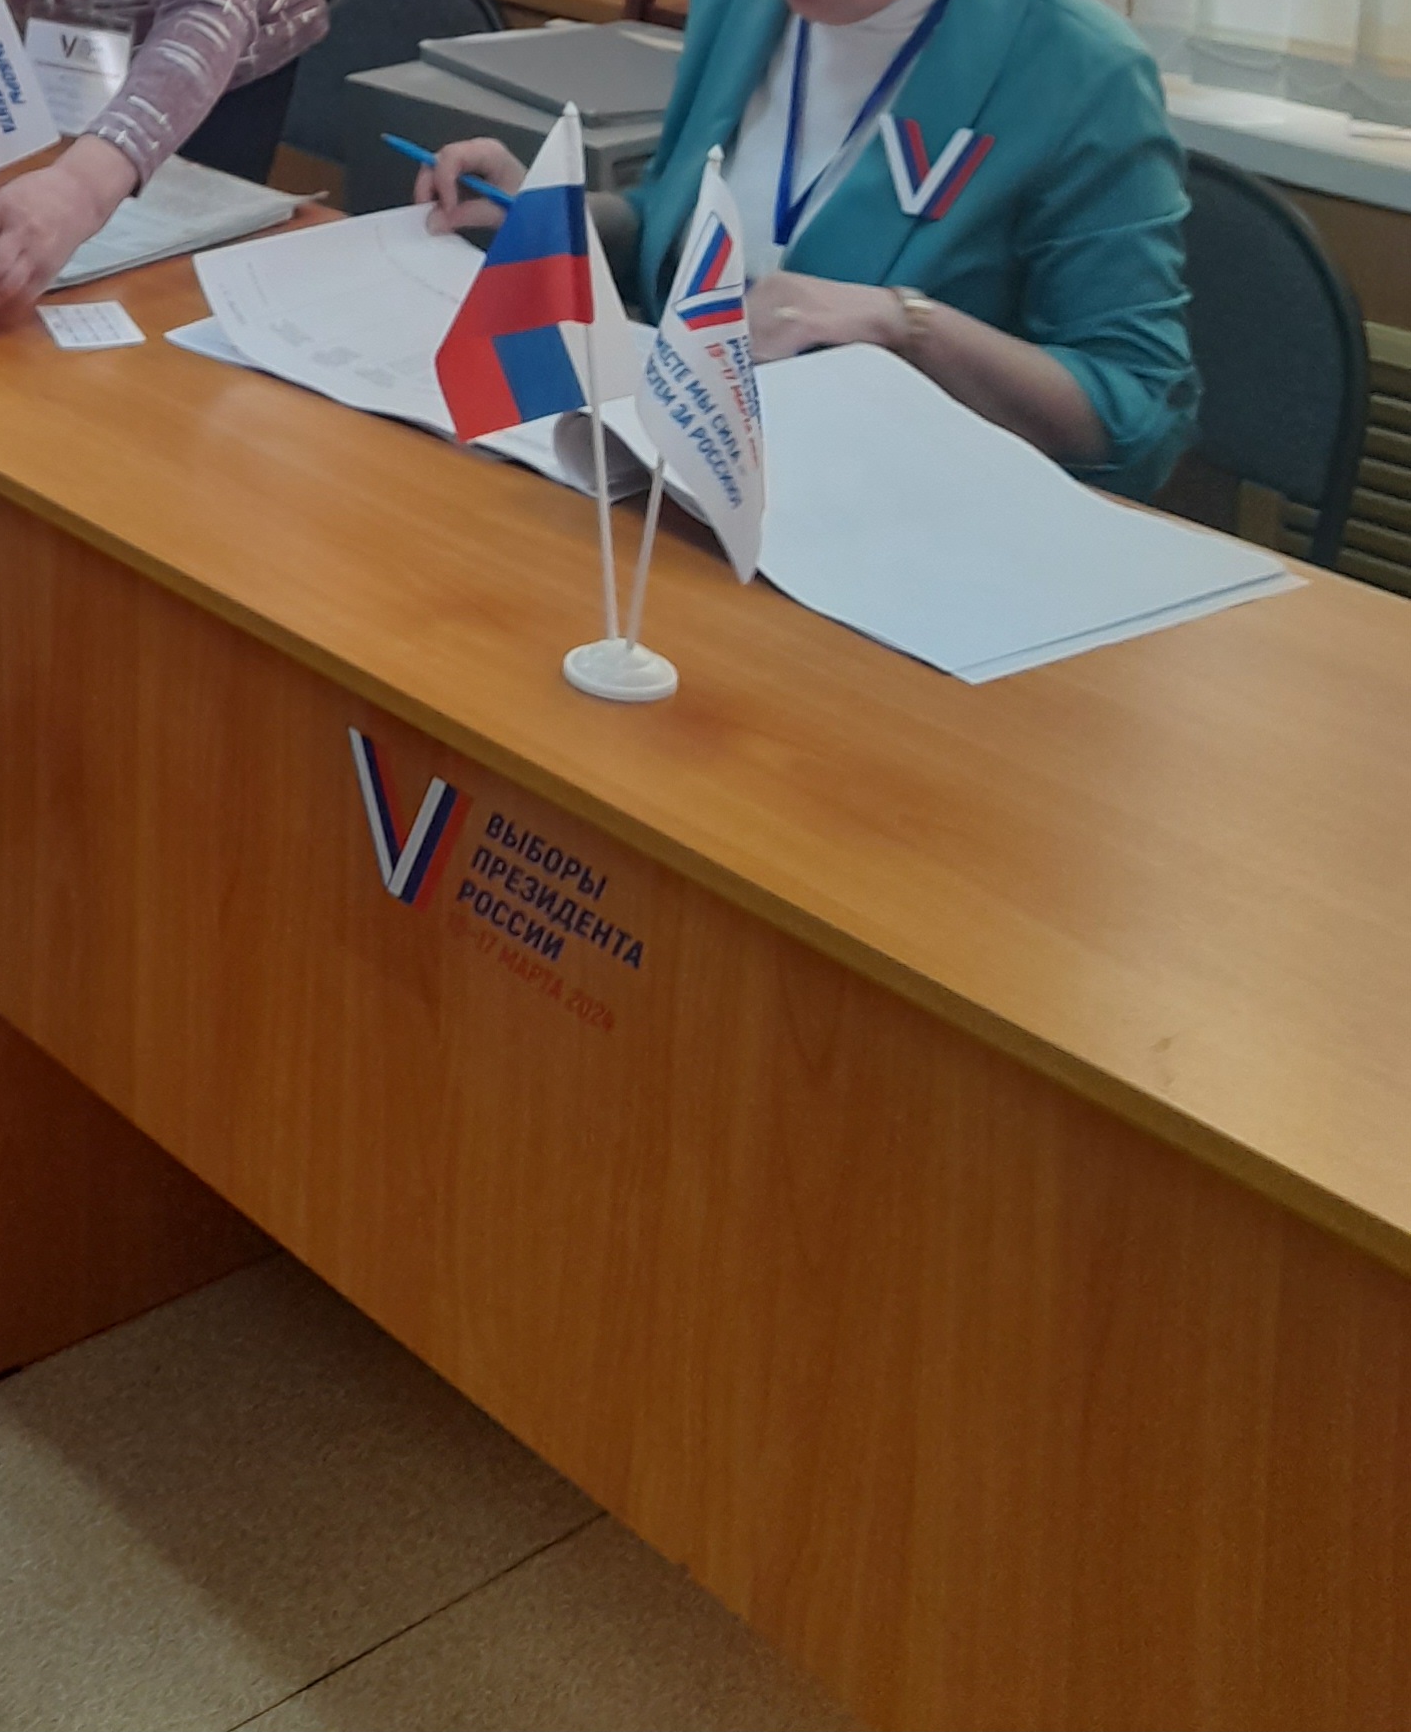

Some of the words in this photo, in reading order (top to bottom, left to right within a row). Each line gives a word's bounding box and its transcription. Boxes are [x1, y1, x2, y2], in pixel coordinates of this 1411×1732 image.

[686, 380, 716, 415] МЫ
[485, 813, 608, 902] ВЫБОРЫ
[456, 879, 565, 962] РОССИИ
[471, 844, 645, 971] ПРЕЗИДЕНТА
